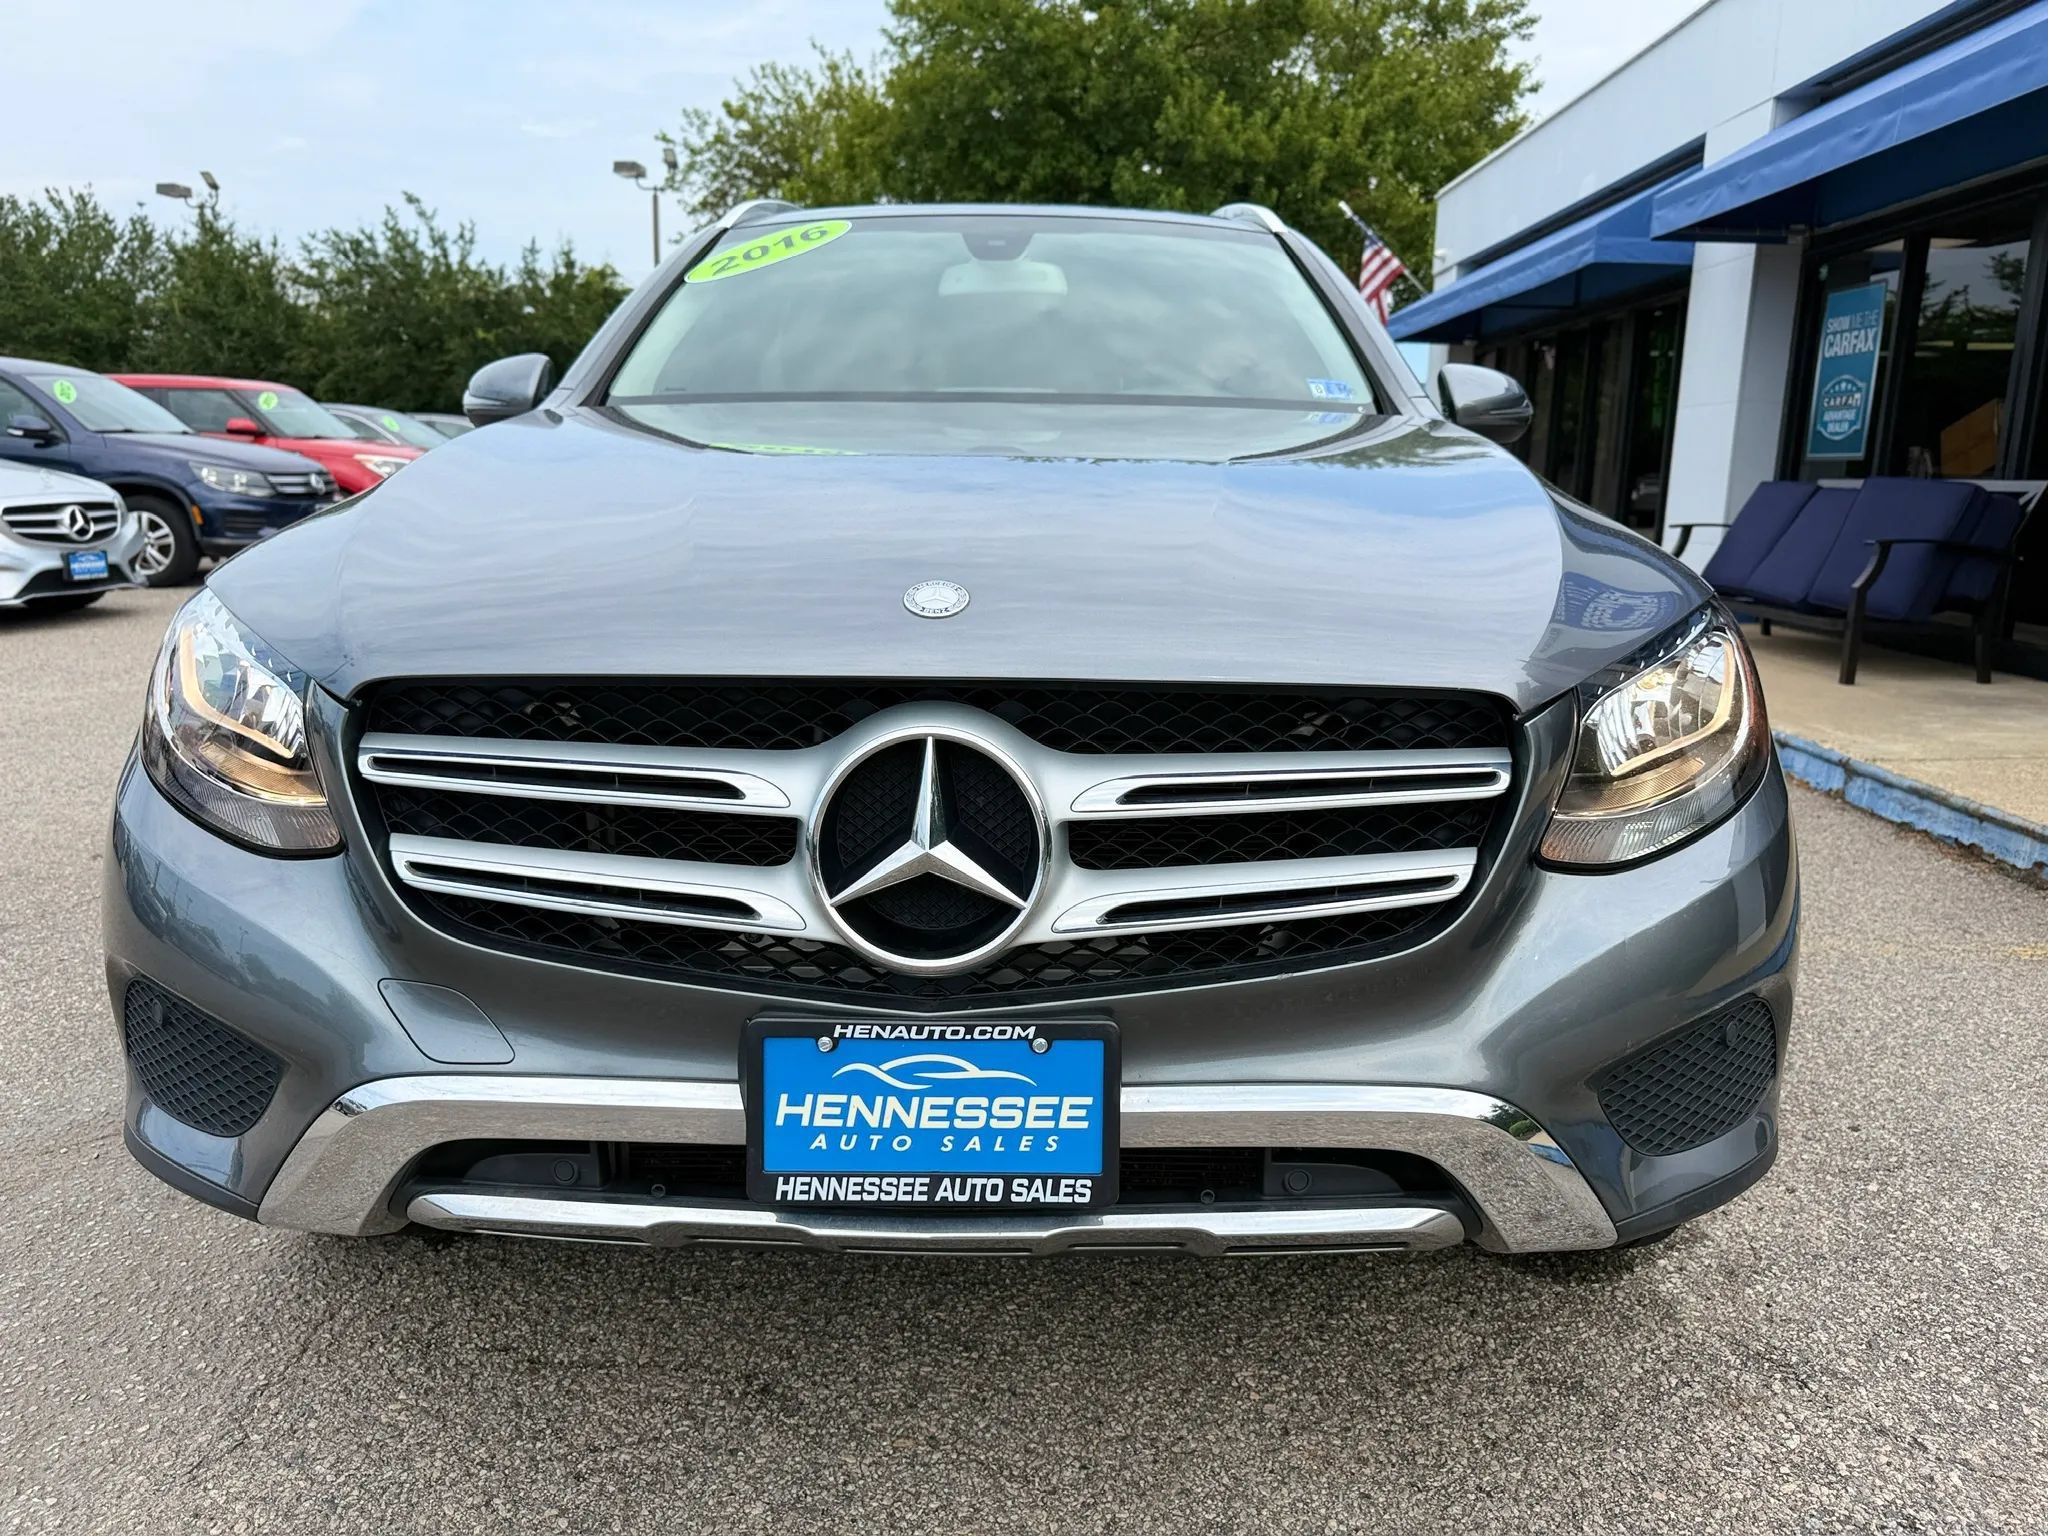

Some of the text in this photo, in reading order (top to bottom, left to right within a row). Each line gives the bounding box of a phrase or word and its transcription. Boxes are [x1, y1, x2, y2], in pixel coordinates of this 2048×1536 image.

[710, 226, 828, 276] 2016
[1824, 328, 1877, 358] CARFAX
[832, 1024, 1037, 1040] HENAUTO.COM
[775, 1093, 1094, 1129] HENNESSEE
[809, 1134, 1060, 1152] AUTO SALES
[775, 1176, 1093, 1204] HENNESSEE AUTO SALES
